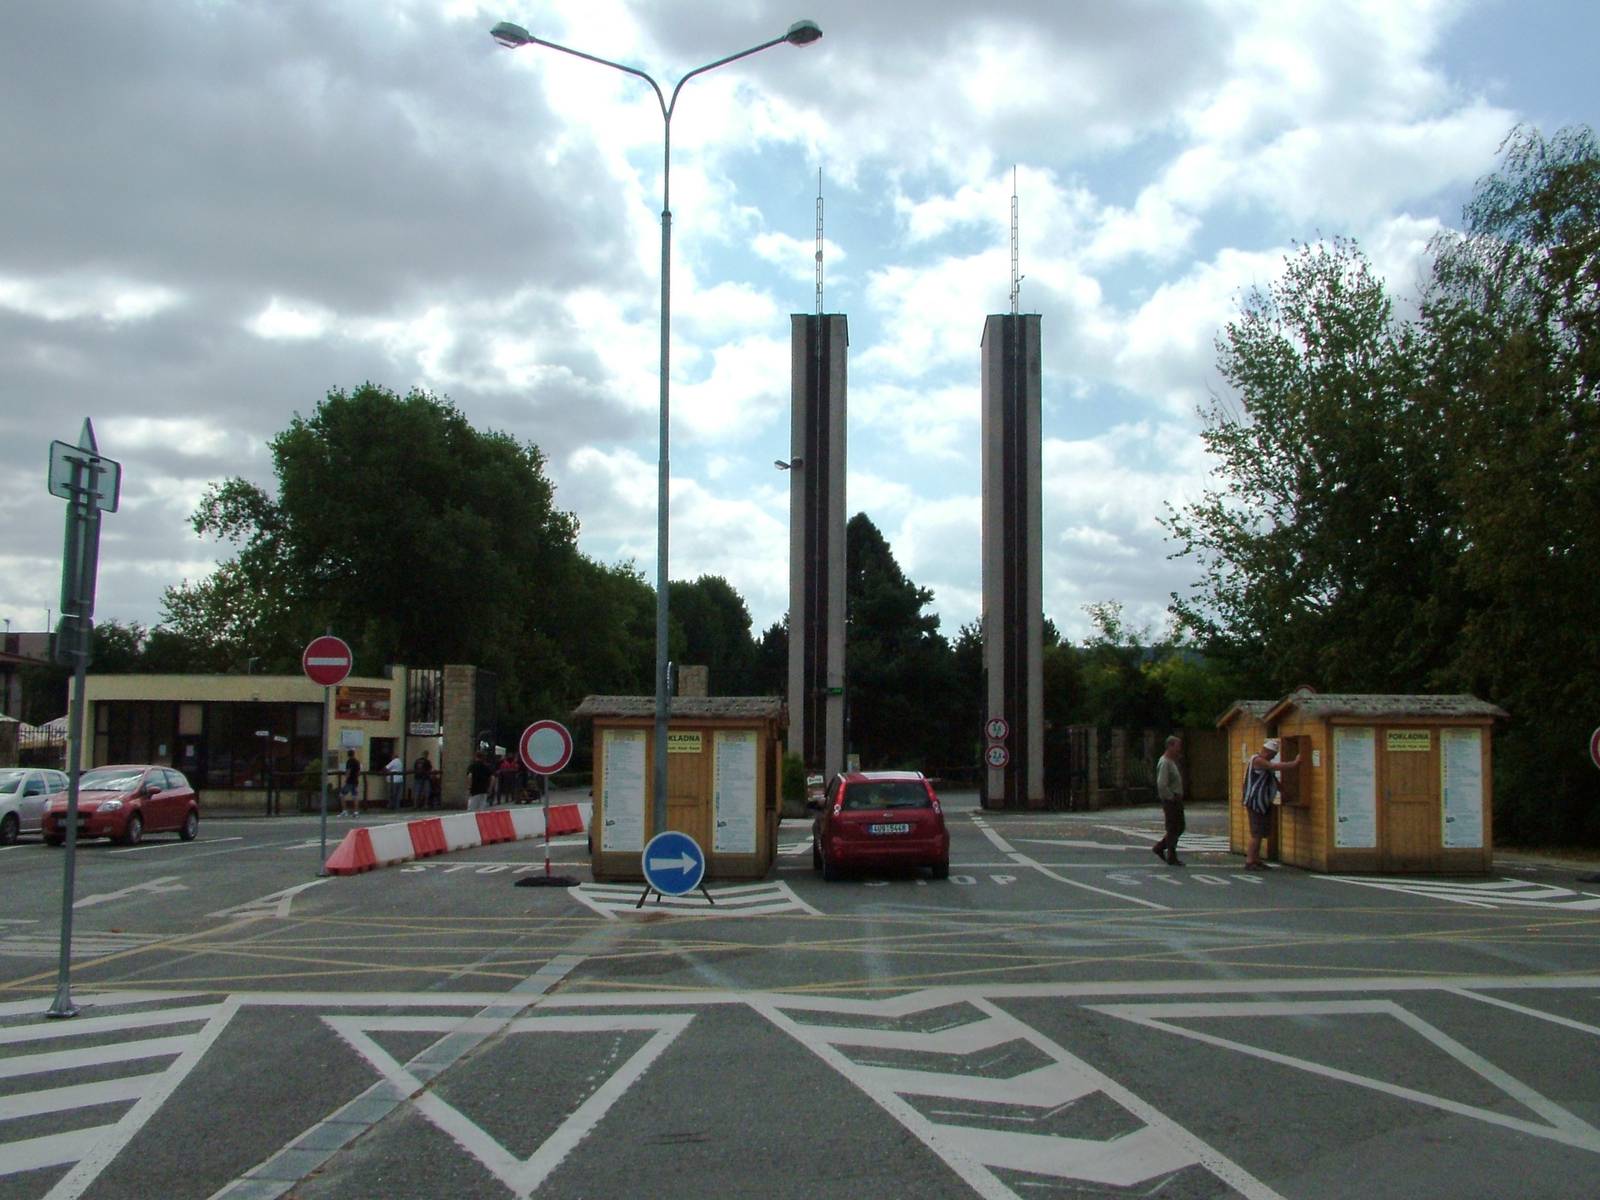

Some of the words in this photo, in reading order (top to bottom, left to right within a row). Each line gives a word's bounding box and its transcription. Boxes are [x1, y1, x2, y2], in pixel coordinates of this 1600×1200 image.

[401, 863, 546, 874] STOP
[863, 874, 1017, 887] OP
[1105, 873, 1264, 886] STOP
